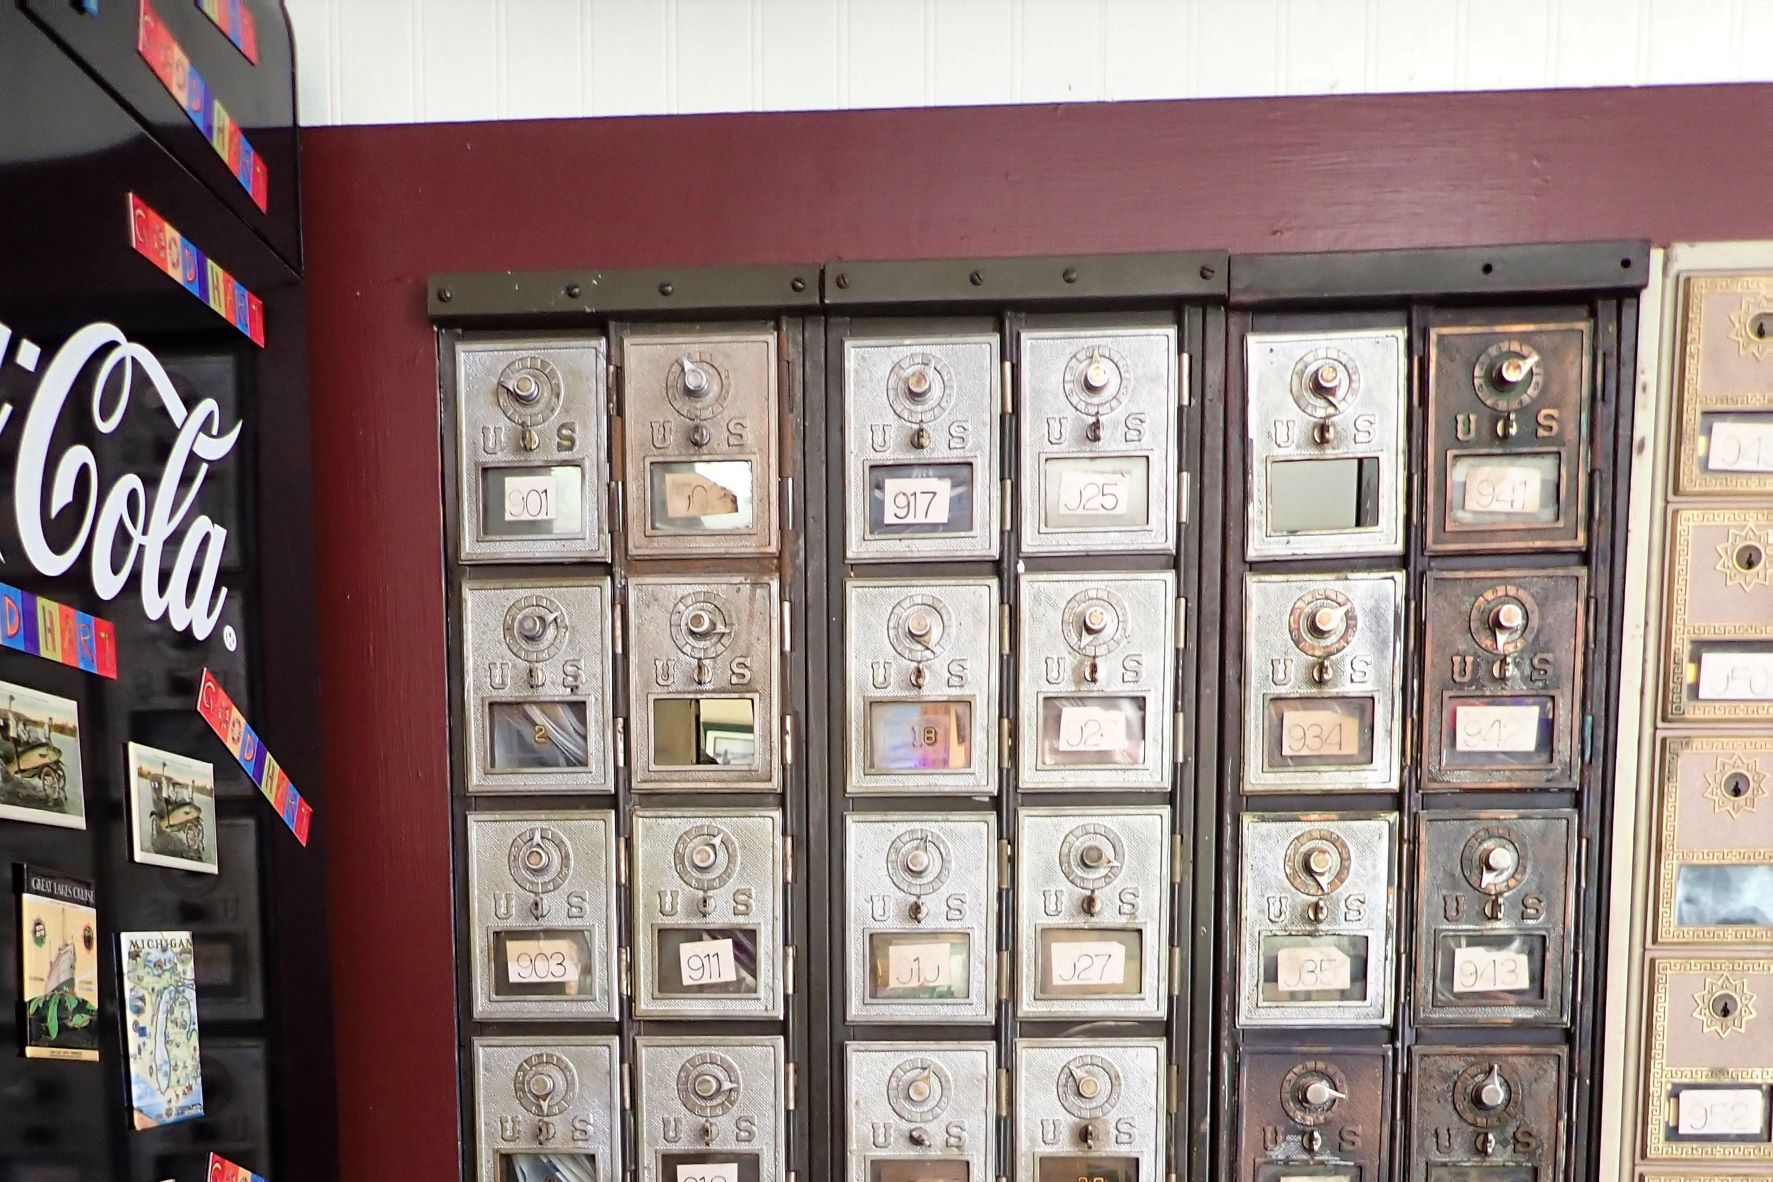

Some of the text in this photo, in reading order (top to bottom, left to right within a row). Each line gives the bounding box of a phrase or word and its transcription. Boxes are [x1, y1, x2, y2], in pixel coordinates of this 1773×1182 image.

[482, 422, 579, 453] U S
[651, 417, 748, 448] U S
[870, 420, 970, 451] U S
[1047, 413, 1146, 444] U S
[1274, 414, 1376, 447] U S
[1456, 409, 1559, 441] U S
[509, 489, 548, 516] 901
[893, 491, 937, 519] 917
[42, 605, 114, 667] HART
[489, 659, 585, 689] U S
[654, 657, 752, 686] U S
[871, 659, 969, 688] U S
[1046, 655, 1143, 684] U S
[1271, 655, 1372, 685] U S
[1452, 653, 1554, 683] U S
[534, 727, 547, 743] 2
[1288, 723, 1342, 752] 934
[32, 877, 52, 893] GREAT
[494, 891, 588, 919] U S
[659, 888, 754, 915] U S
[870, 893, 967, 920] U S
[1043, 888, 1139, 916] U S
[1267, 894, 1367, 922] U S
[1444, 894, 1544, 922] U S
[129, 938, 193, 950] MICHIGAN
[517, 952, 566, 979] 903
[687, 953, 722, 981] 911
[500, 1114, 593, 1141] U S
[663, 1116, 757, 1141] U S
[872, 1121, 967, 1148] U S
[1041, 1118, 1137, 1144] U S
[1263, 1127, 1361, 1151] U S
[1435, 1127, 1536, 1154] U S
